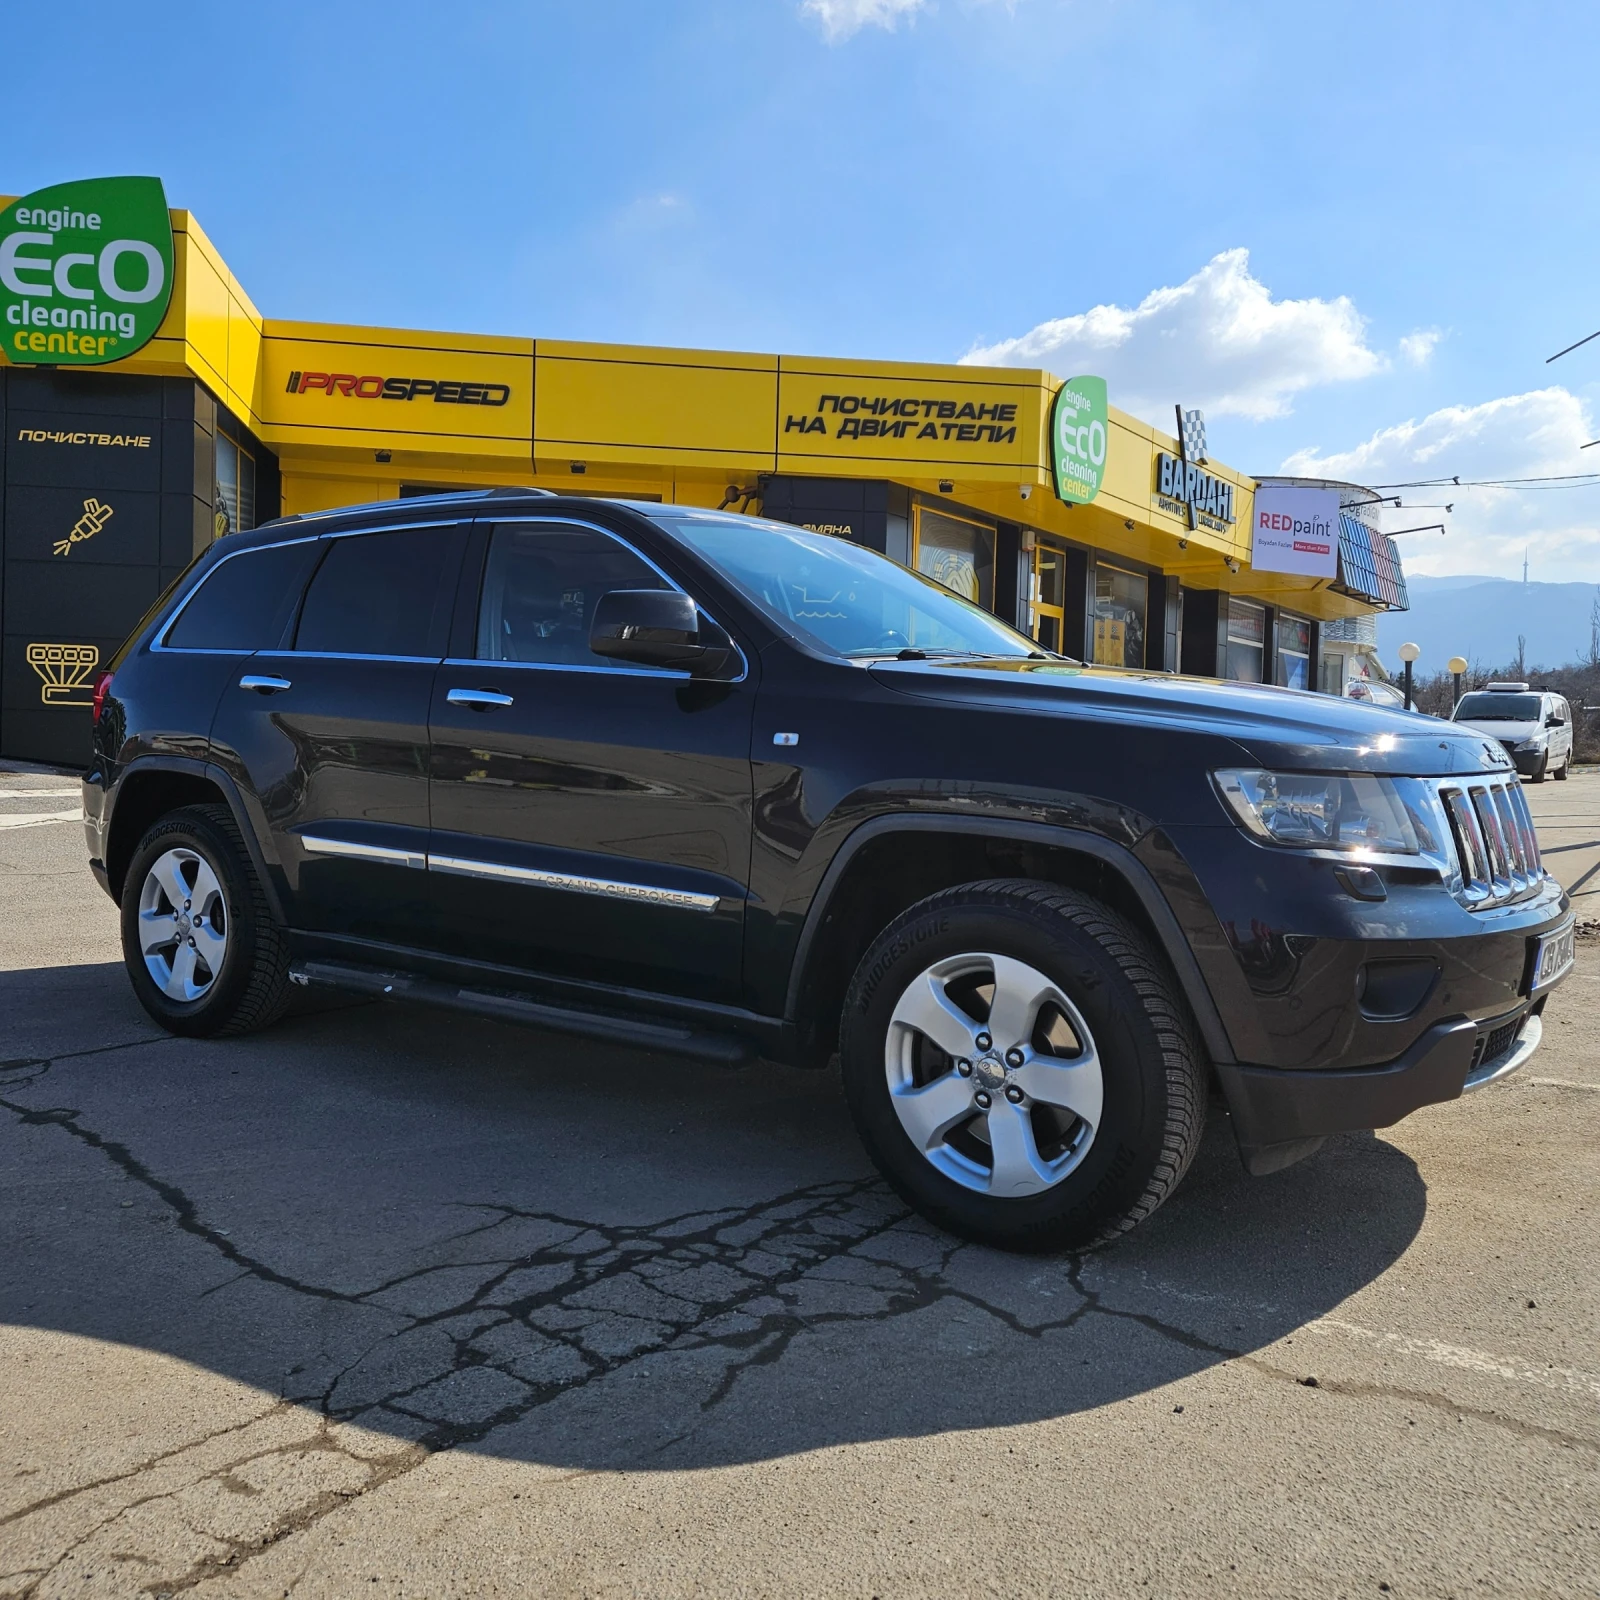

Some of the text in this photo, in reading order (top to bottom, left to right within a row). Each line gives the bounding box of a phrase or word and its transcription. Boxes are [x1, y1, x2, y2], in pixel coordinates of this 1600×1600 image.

[15, 206, 101, 232] engine
[6, 300, 136, 338] cleaning
[298, 371, 511, 407] PROSPEED
[1065, 389, 1091, 412] engine
[817, 394, 1018, 422] ПОЧИСТВАНЕ
[18, 429, 151, 448] ПОЧИСТВАНЕ
[784, 415, 1017, 444] НА ДВИГАТЕЛИ
[1061, 455, 1097, 488] cleaning
[1157, 452, 1237, 526] BARDAHL
[1260, 512, 1331, 537] REDpaint
[545, 875, 693, 908] GRAND CHEROKEE
